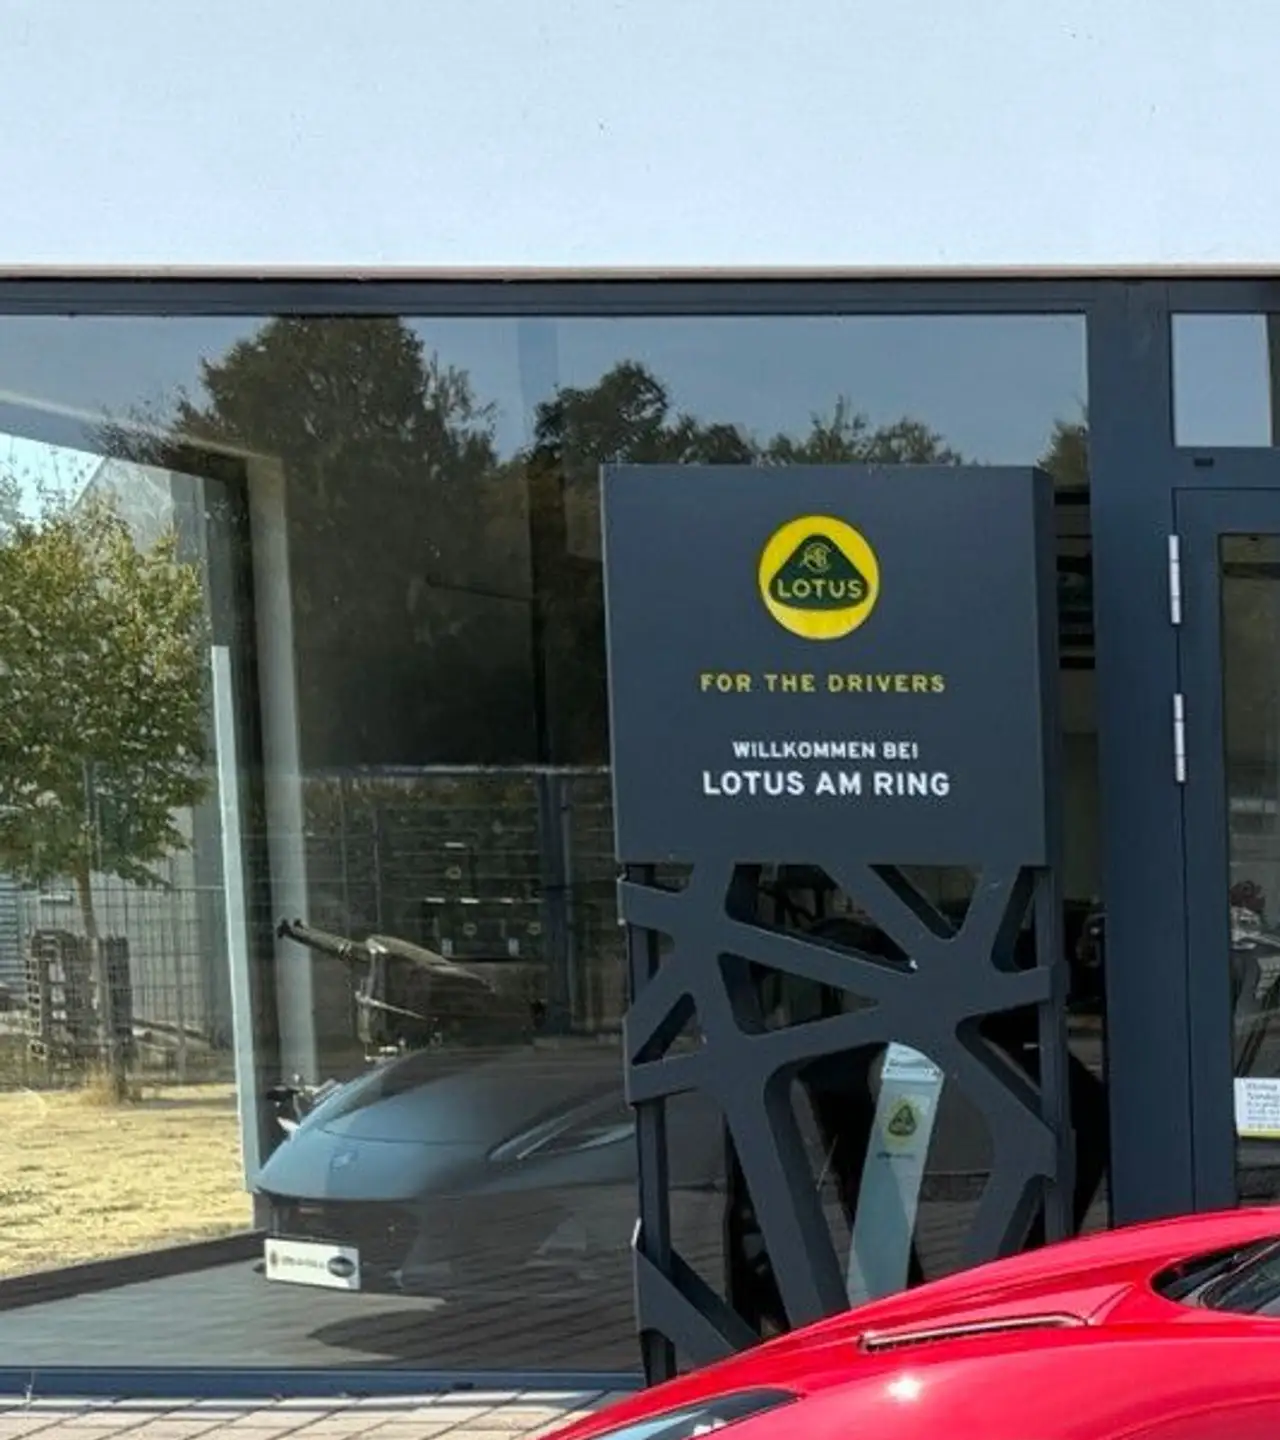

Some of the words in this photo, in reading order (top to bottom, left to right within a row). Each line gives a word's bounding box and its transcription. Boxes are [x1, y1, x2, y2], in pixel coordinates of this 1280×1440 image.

[777, 578, 862, 599] LOTUS
[700, 673, 751, 693] FOR
[764, 673, 816, 693] THE
[828, 673, 946, 693] DRIVERS
[732, 741, 876, 759] WILLKOMMEN
[883, 741, 918, 760] BEI
[703, 770, 805, 796] LOTUS
[815, 771, 862, 796] AM
[874, 772, 949, 796] RING
